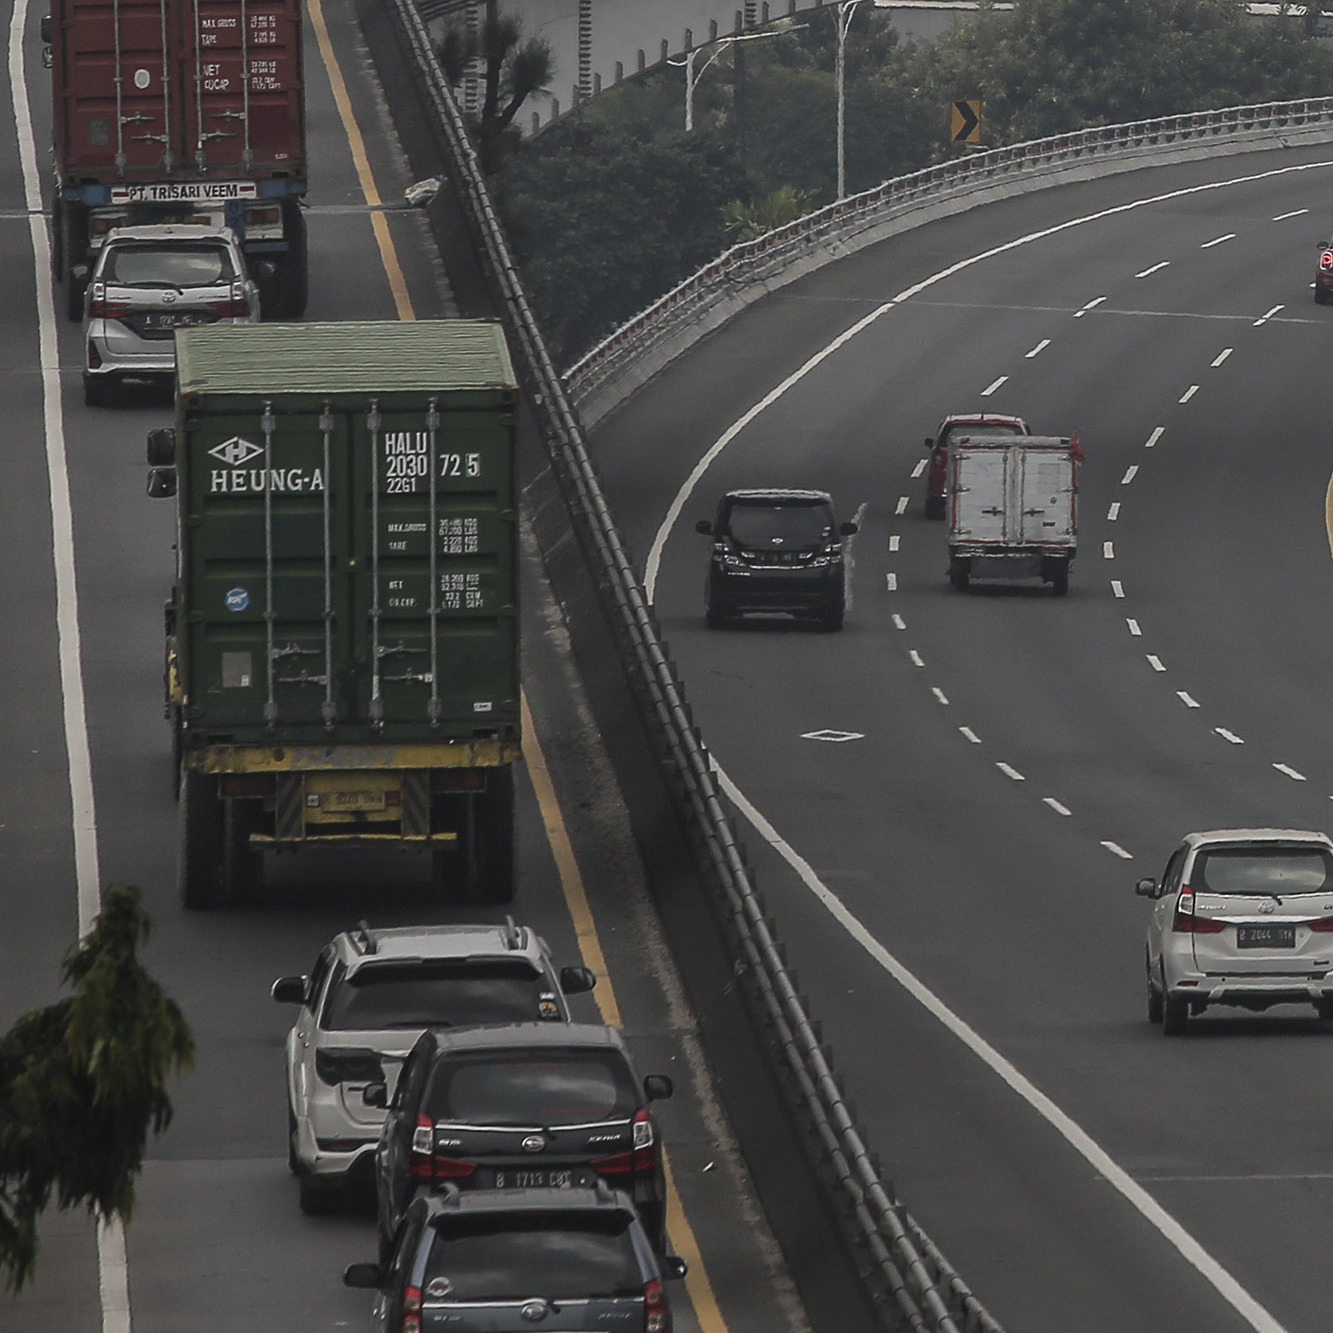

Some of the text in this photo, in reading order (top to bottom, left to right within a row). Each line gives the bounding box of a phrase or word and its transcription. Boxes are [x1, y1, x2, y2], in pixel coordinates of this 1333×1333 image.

[129, 184, 238, 201] PT. TRISARI VEEM
[385, 432, 428, 455] HALU
[385, 453, 480, 477] 2030 72 5
[210, 468, 325, 493] HEUNG-A
[386, 477, 416, 494] 22G1
